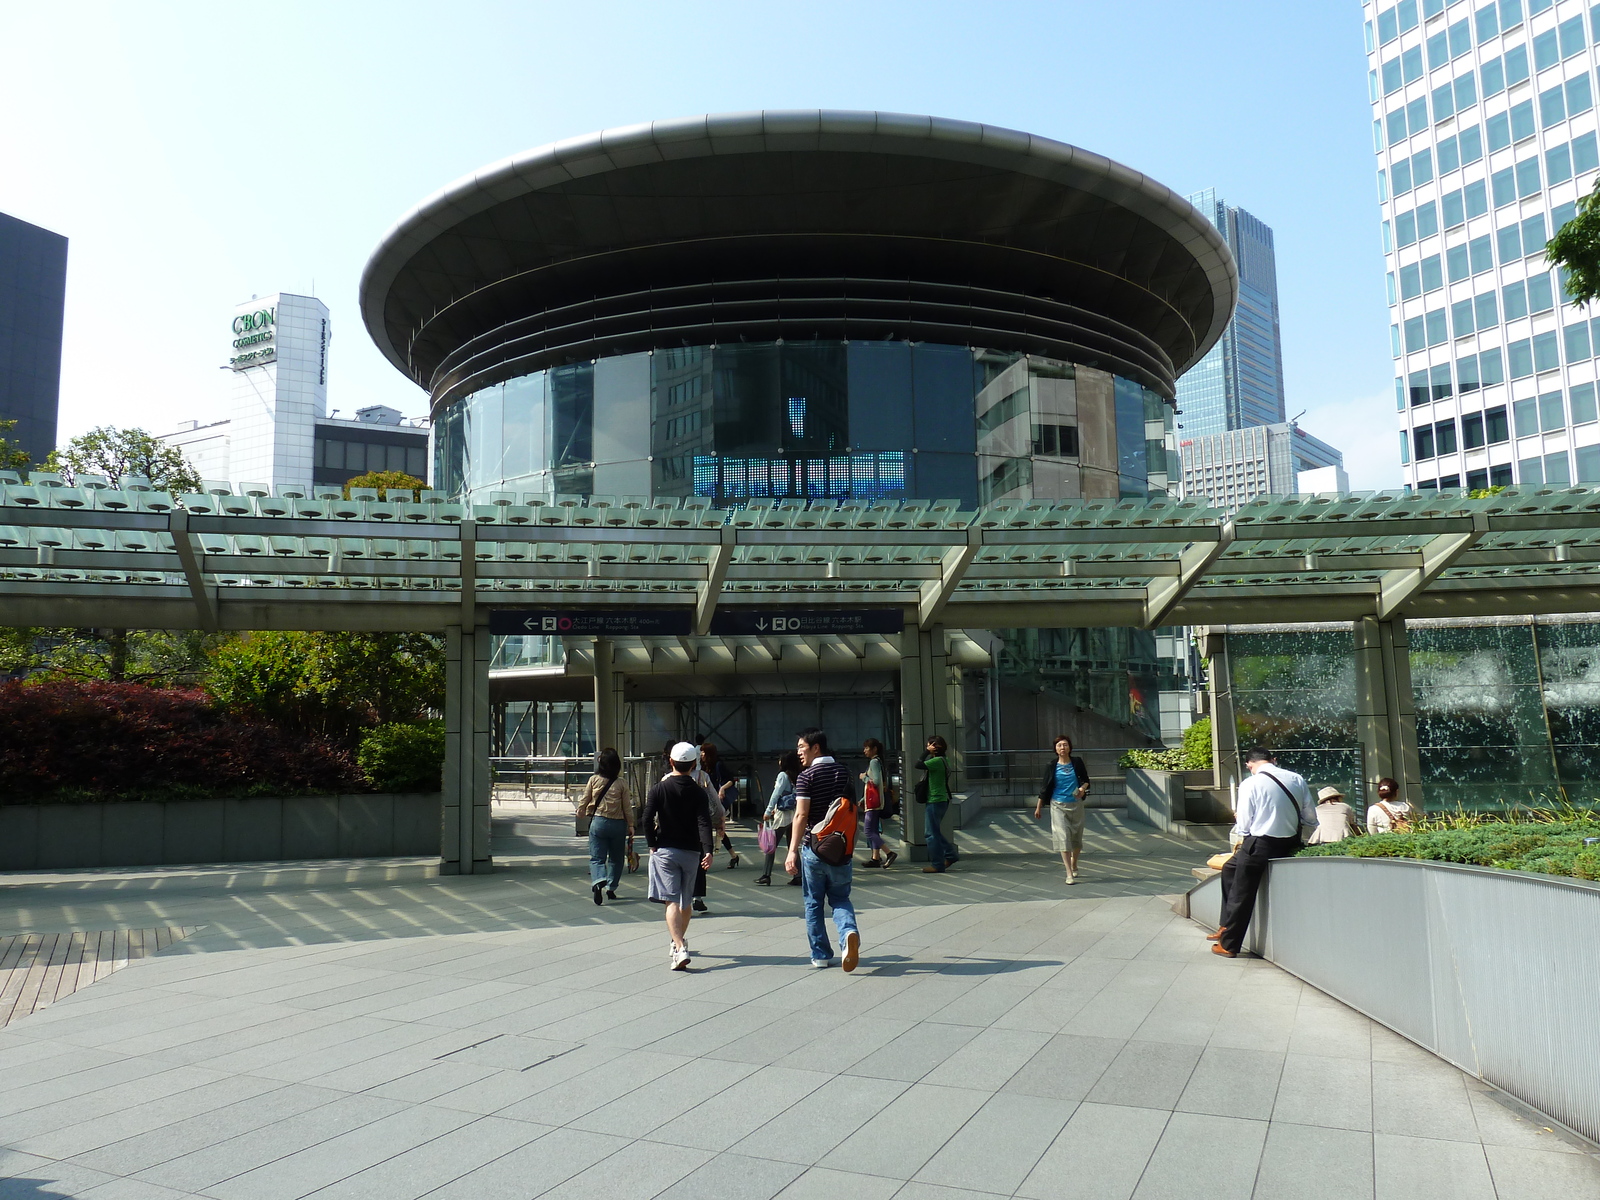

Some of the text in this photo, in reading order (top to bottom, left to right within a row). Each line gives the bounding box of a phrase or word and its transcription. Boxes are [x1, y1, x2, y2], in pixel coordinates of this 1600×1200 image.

[232, 331, 273, 349] COSMETICS
[572, 616, 604, 625] 大江戸線
[605, 616, 638, 625] 六本木駅
[801, 616, 862, 624] 日比谷線 六本木駅
